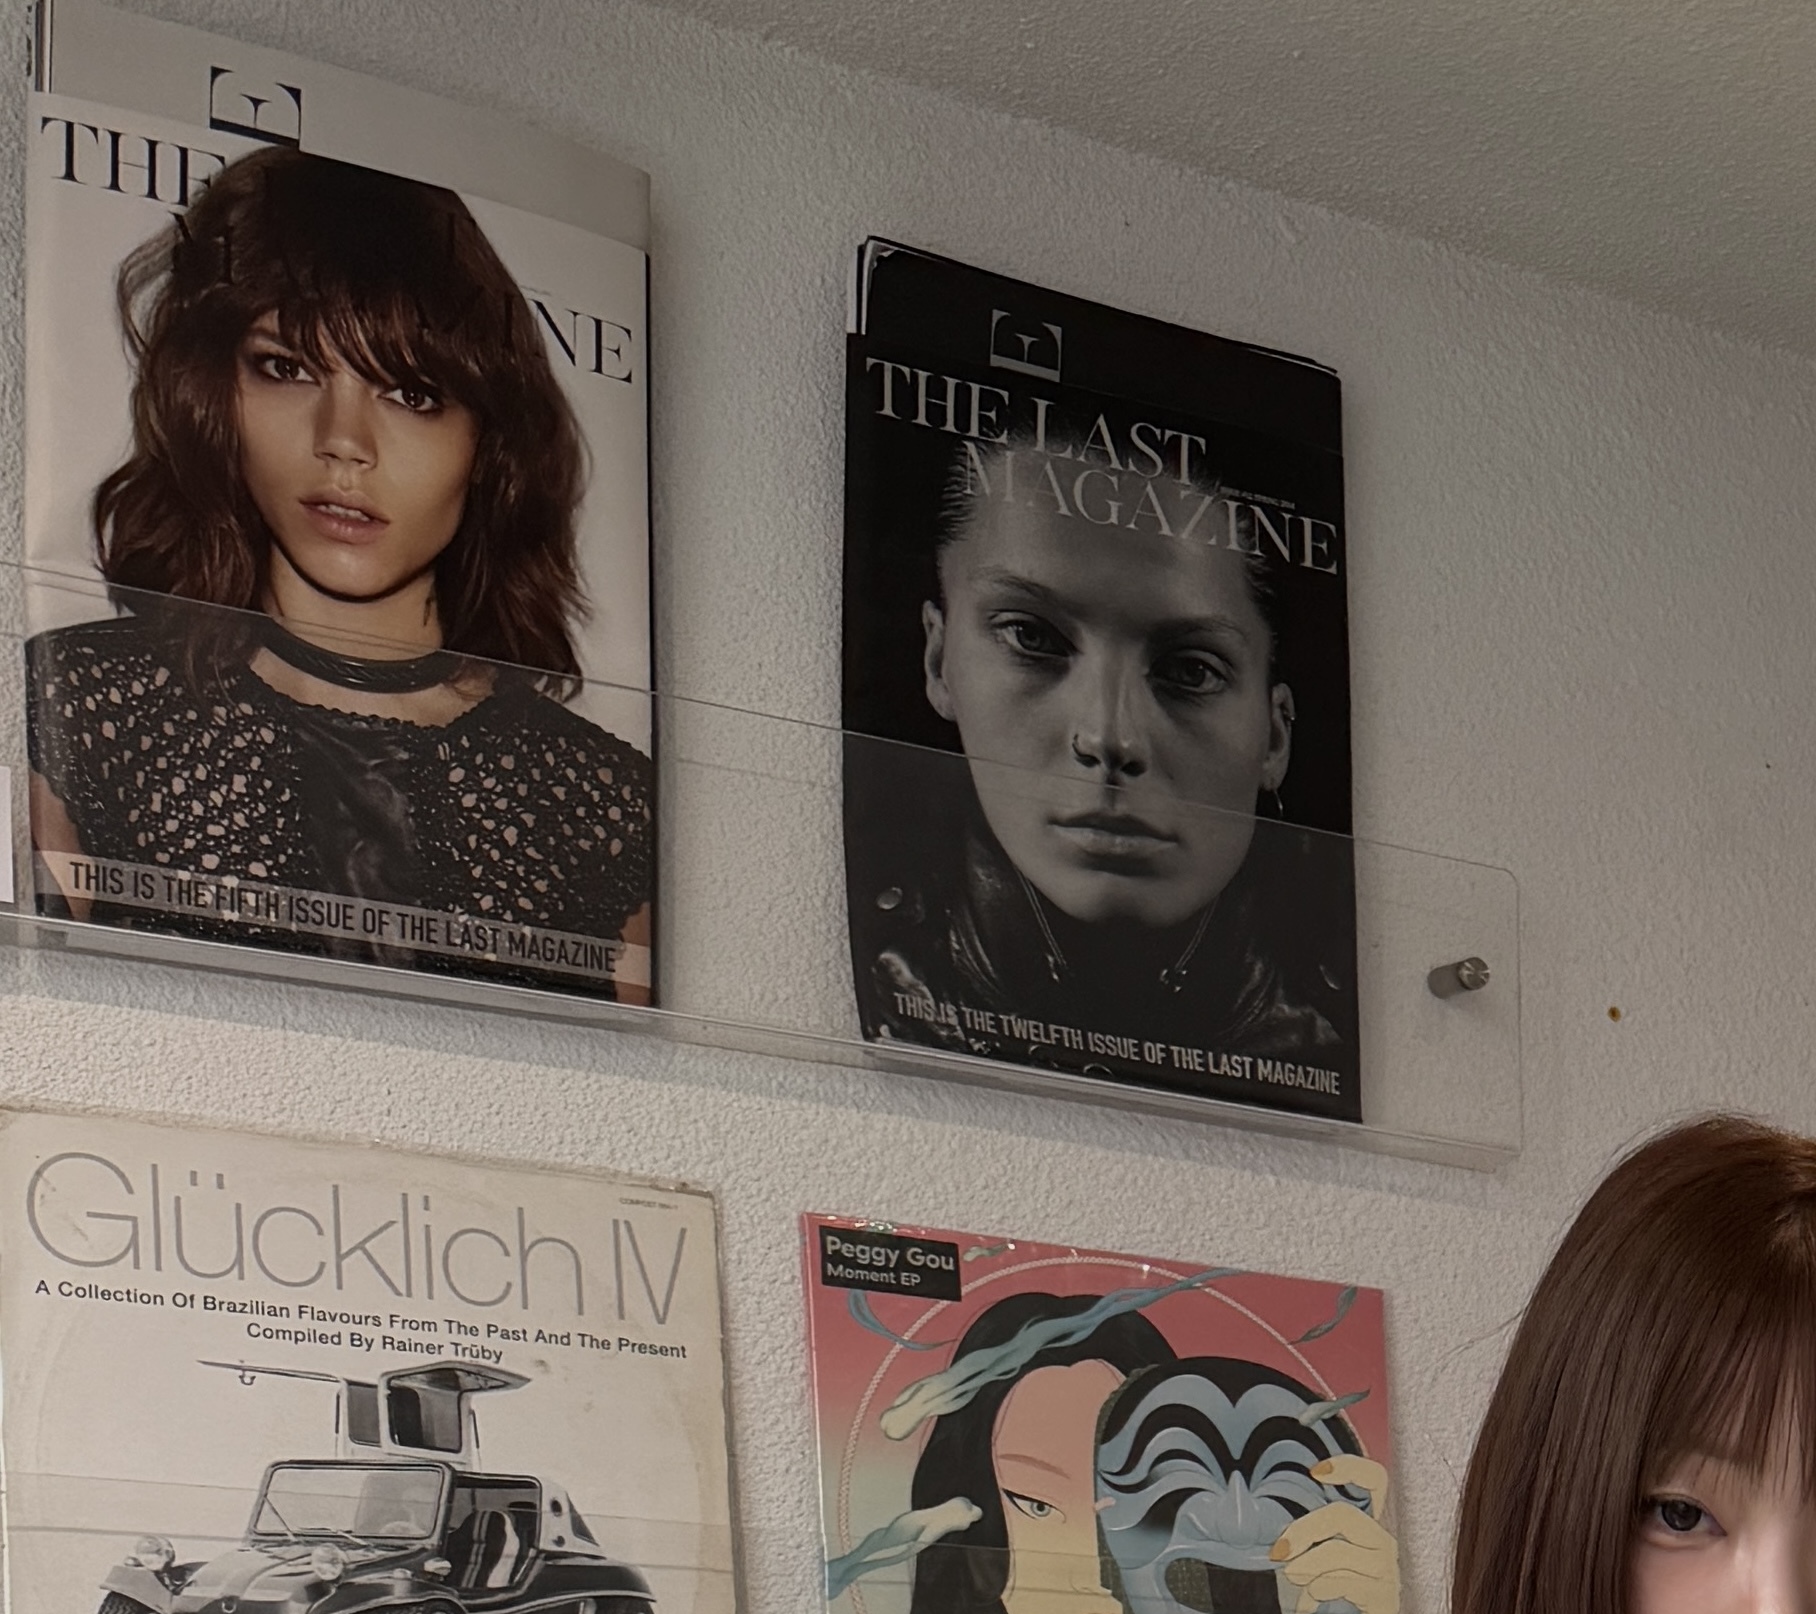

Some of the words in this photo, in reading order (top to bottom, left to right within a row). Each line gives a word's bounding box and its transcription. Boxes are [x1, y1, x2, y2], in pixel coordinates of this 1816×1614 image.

[866, 357, 1010, 445] THE
[1030, 396, 1207, 487] LAST
[961, 440, 1338, 575] MAGAZINE
[70, 861, 123, 895] THIS
[132, 871, 156, 901] IS
[163, 874, 208, 908] THE
[214, 885, 281, 922] FIFTH
[287, 892, 356, 930] ISSUE
[362, 908, 391, 936] OF
[397, 912, 440, 946] THE
[445, 920, 501, 955] LAST
[508, 930, 618, 974] MAGAZINE
[894, 993, 935, 1021] THIS
[937, 1002, 958, 1025] IS
[962, 1006, 998, 1034] THE
[1000, 1013, 1085, 1052] TWELFTH
[1088, 1031, 1140, 1062] ISSUE
[1144, 1042, 1168, 1066] OF
[1170, 1046, 1205, 1074] THE
[1208, 1051, 1254, 1081] LAST
[1257, 1058, 1342, 1096] MAGAZINE
[27, 1152, 585, 1316] Glücklich
[612, 1217, 689, 1326] IV
[826, 1235, 899, 1267] Peggy
[906, 1247, 954, 1271] Gou
[827, 1263, 896, 1284] Moment
[901, 1272, 921, 1287] EP
[35, 1280, 52, 1297] A
[57, 1281, 166, 1308] Collection
[172, 1290, 197, 1310] Of
[202, 1294, 291, 1320] Brazilian
[297, 1303, 383, 1330] Flavours
[388, 1314, 438, 1335] From
[443, 1318, 481, 1338] The
[486, 1323, 529, 1345] Past
[534, 1327, 572, 1348] And
[577, 1332, 612, 1352] The
[617, 1337, 688, 1360] Present
[246, 1322, 343, 1350] Compiled
[348, 1330, 376, 1352] By
[381, 1335, 445, 1357] Rainer
[450, 1340, 504, 1366] Trüby
